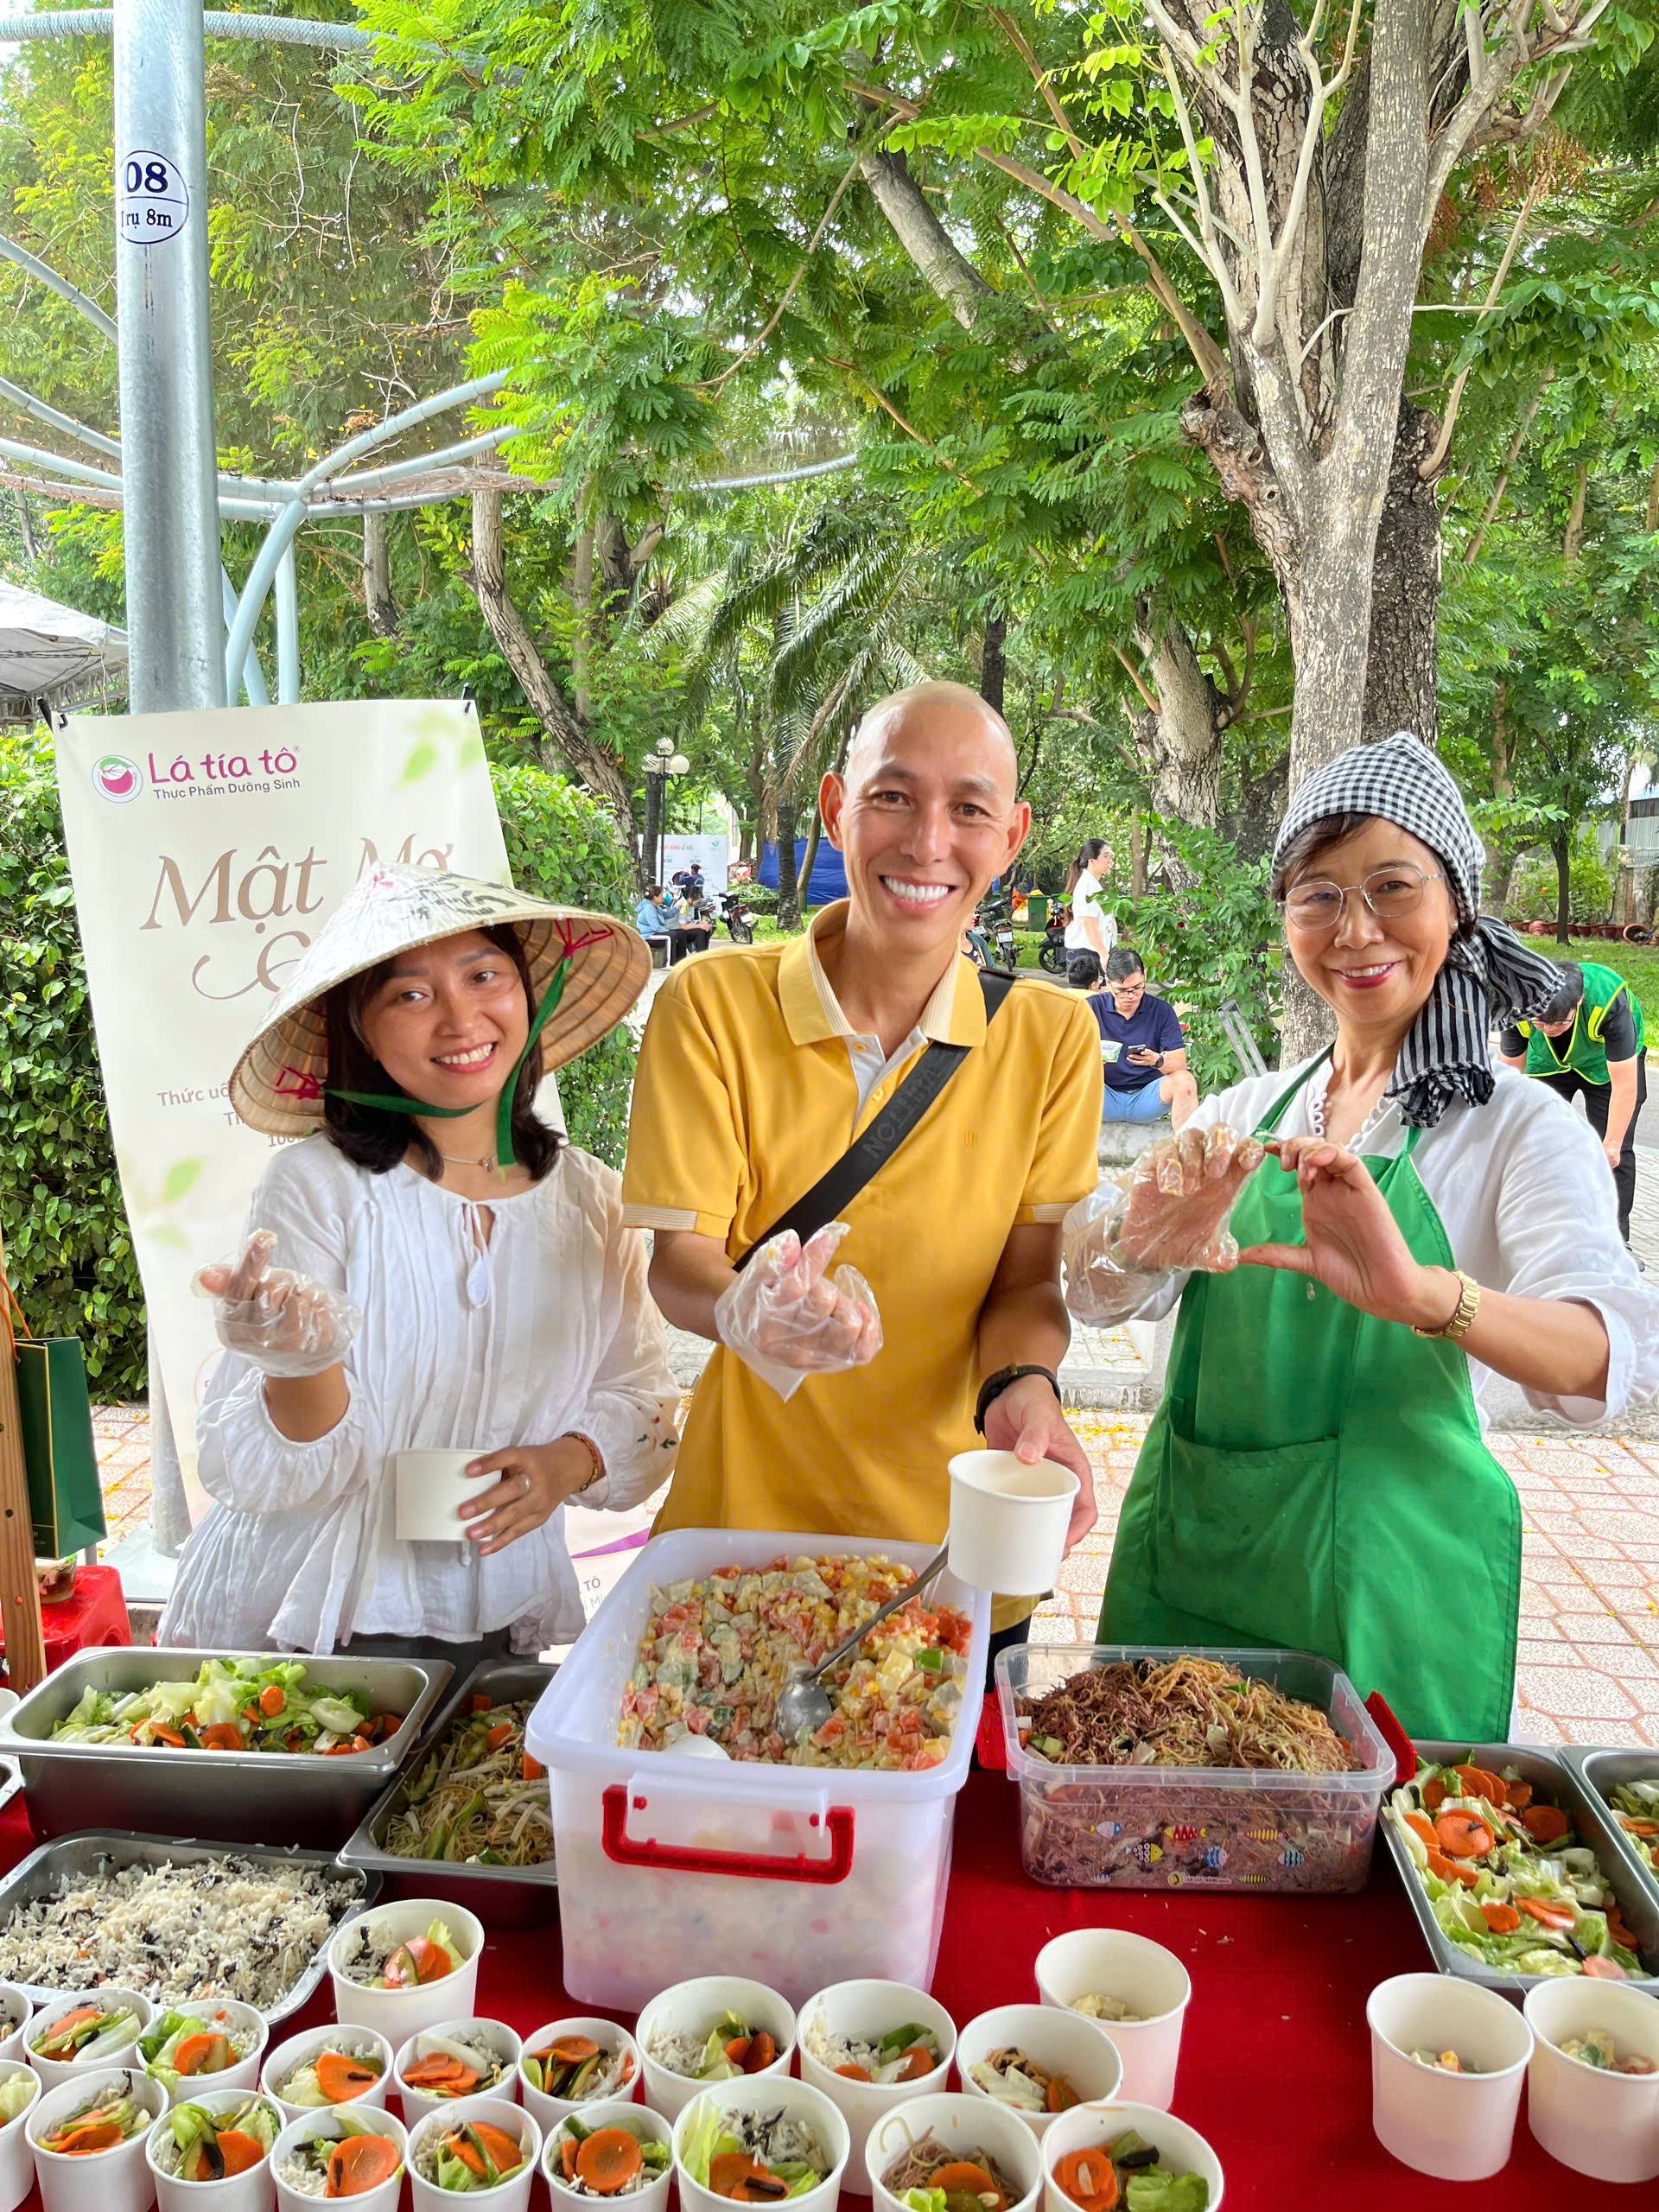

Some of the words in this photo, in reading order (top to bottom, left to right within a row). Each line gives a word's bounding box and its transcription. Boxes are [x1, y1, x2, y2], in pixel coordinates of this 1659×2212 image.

[124, 162, 168, 193] 08
[146, 208, 174, 228] 8m
[149, 753, 195, 784] Lá
[200, 753, 252, 779] tía
[257, 747, 297, 775] tô
[153, 788, 187, 800] Thực
[189, 784, 225, 798] Phẩm
[228, 779, 270, 793] Dưỡng
[273, 779, 301, 790] Sinh
[139, 845, 328, 934] Mật
[157, 1087, 205, 1107] Thức
[583, 1575, 601, 1591] TÔ
